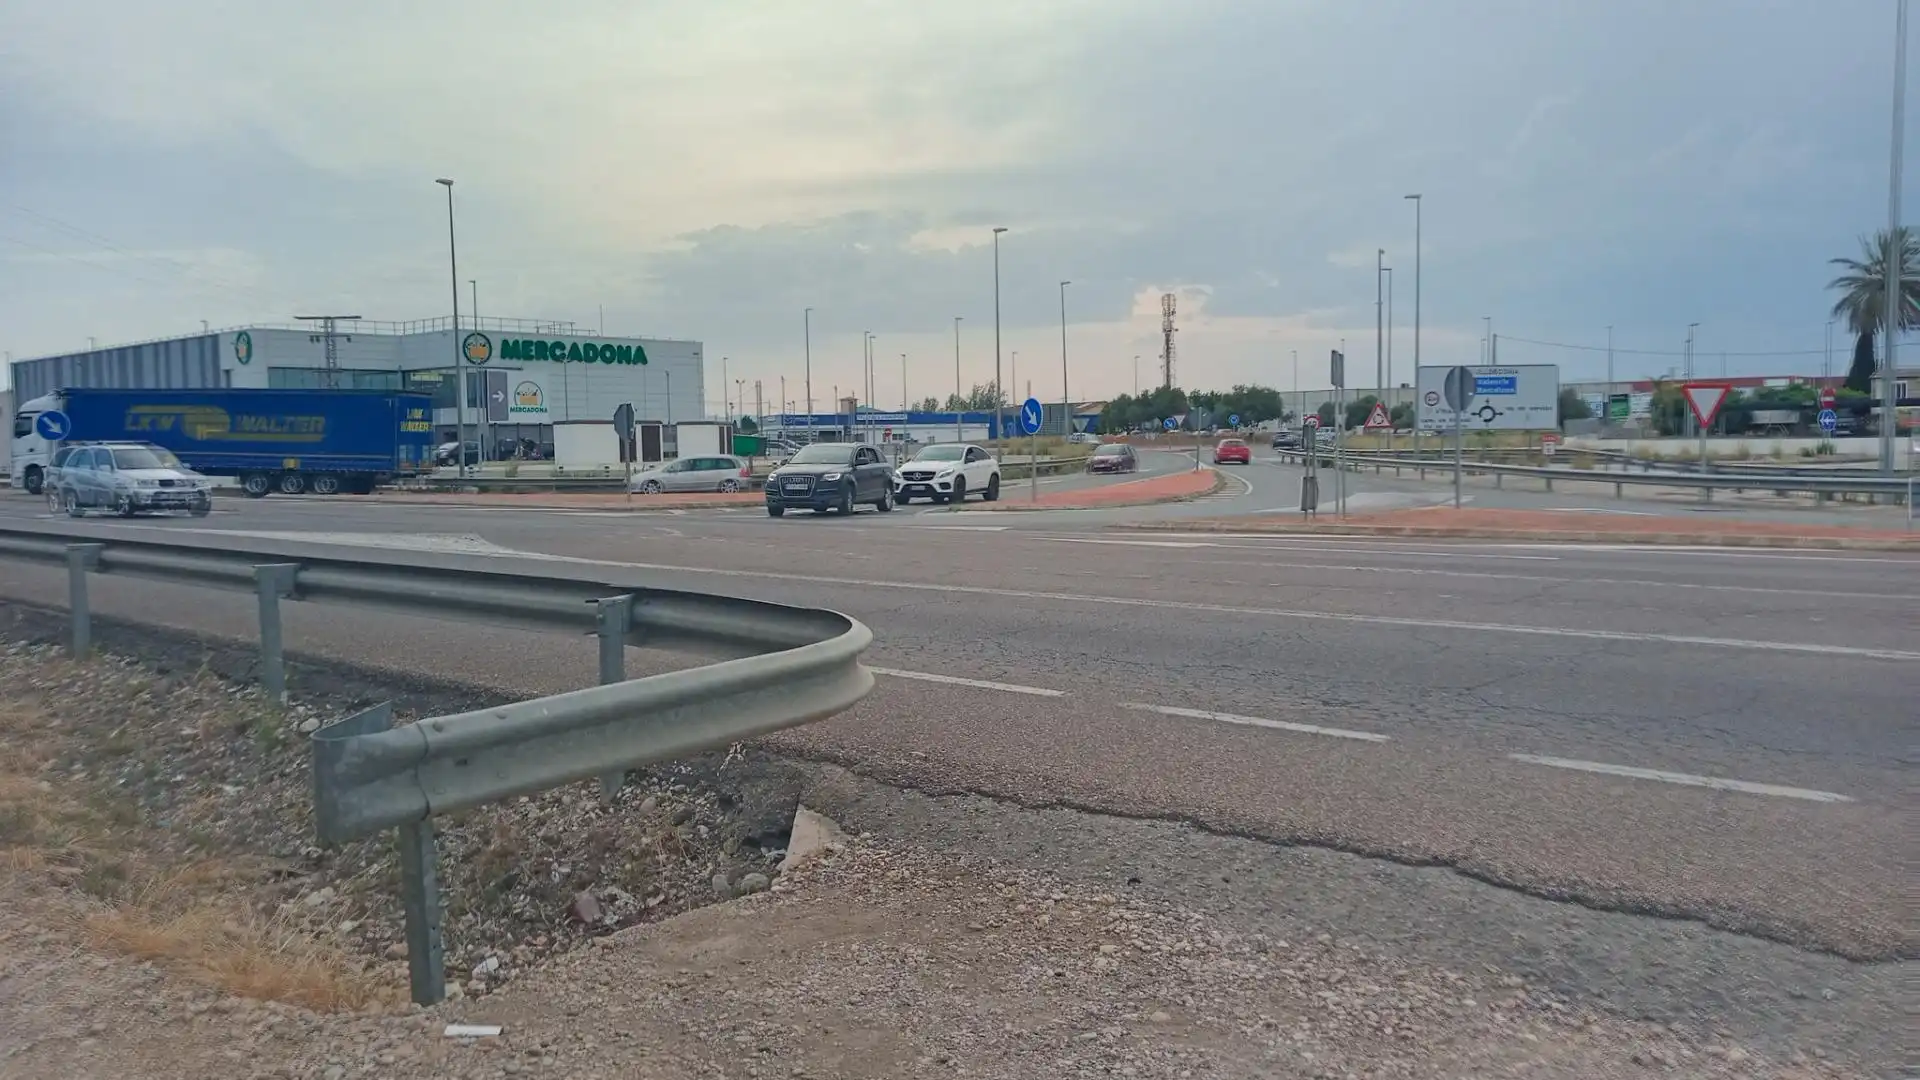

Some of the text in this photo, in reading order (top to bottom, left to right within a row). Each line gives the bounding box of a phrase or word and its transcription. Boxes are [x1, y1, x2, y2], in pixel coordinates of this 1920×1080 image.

[501, 339, 648, 365] MERCADONA
[509, 406, 548, 414] MERCADONA
[236, 415, 326, 433] WALTER
